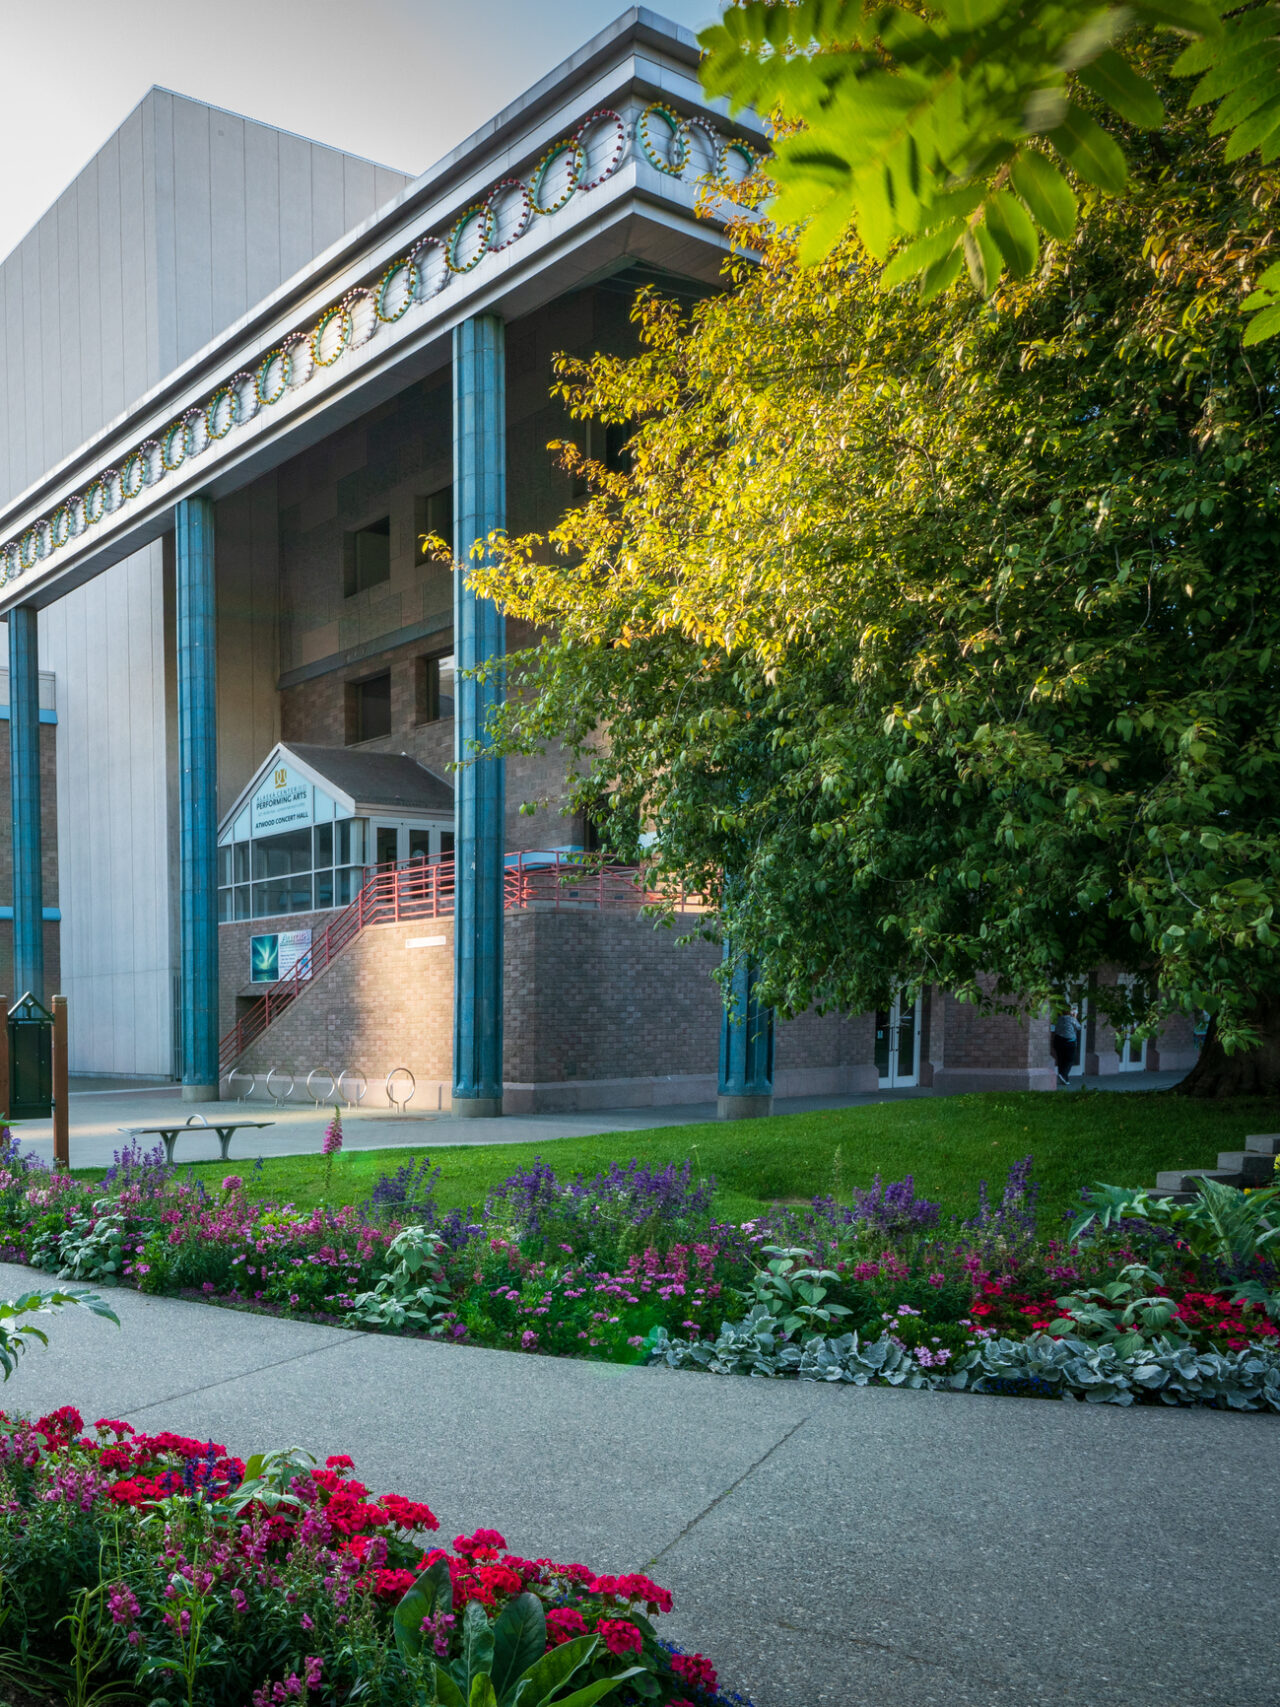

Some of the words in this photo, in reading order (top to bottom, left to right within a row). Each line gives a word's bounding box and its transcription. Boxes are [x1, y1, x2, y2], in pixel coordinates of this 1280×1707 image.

[256, 795, 291, 810] PERFORMING
[293, 791, 307, 800] ARTS
[255, 819, 275, 828] ATWOOD
[275, 814, 296, 824] CONCERT
